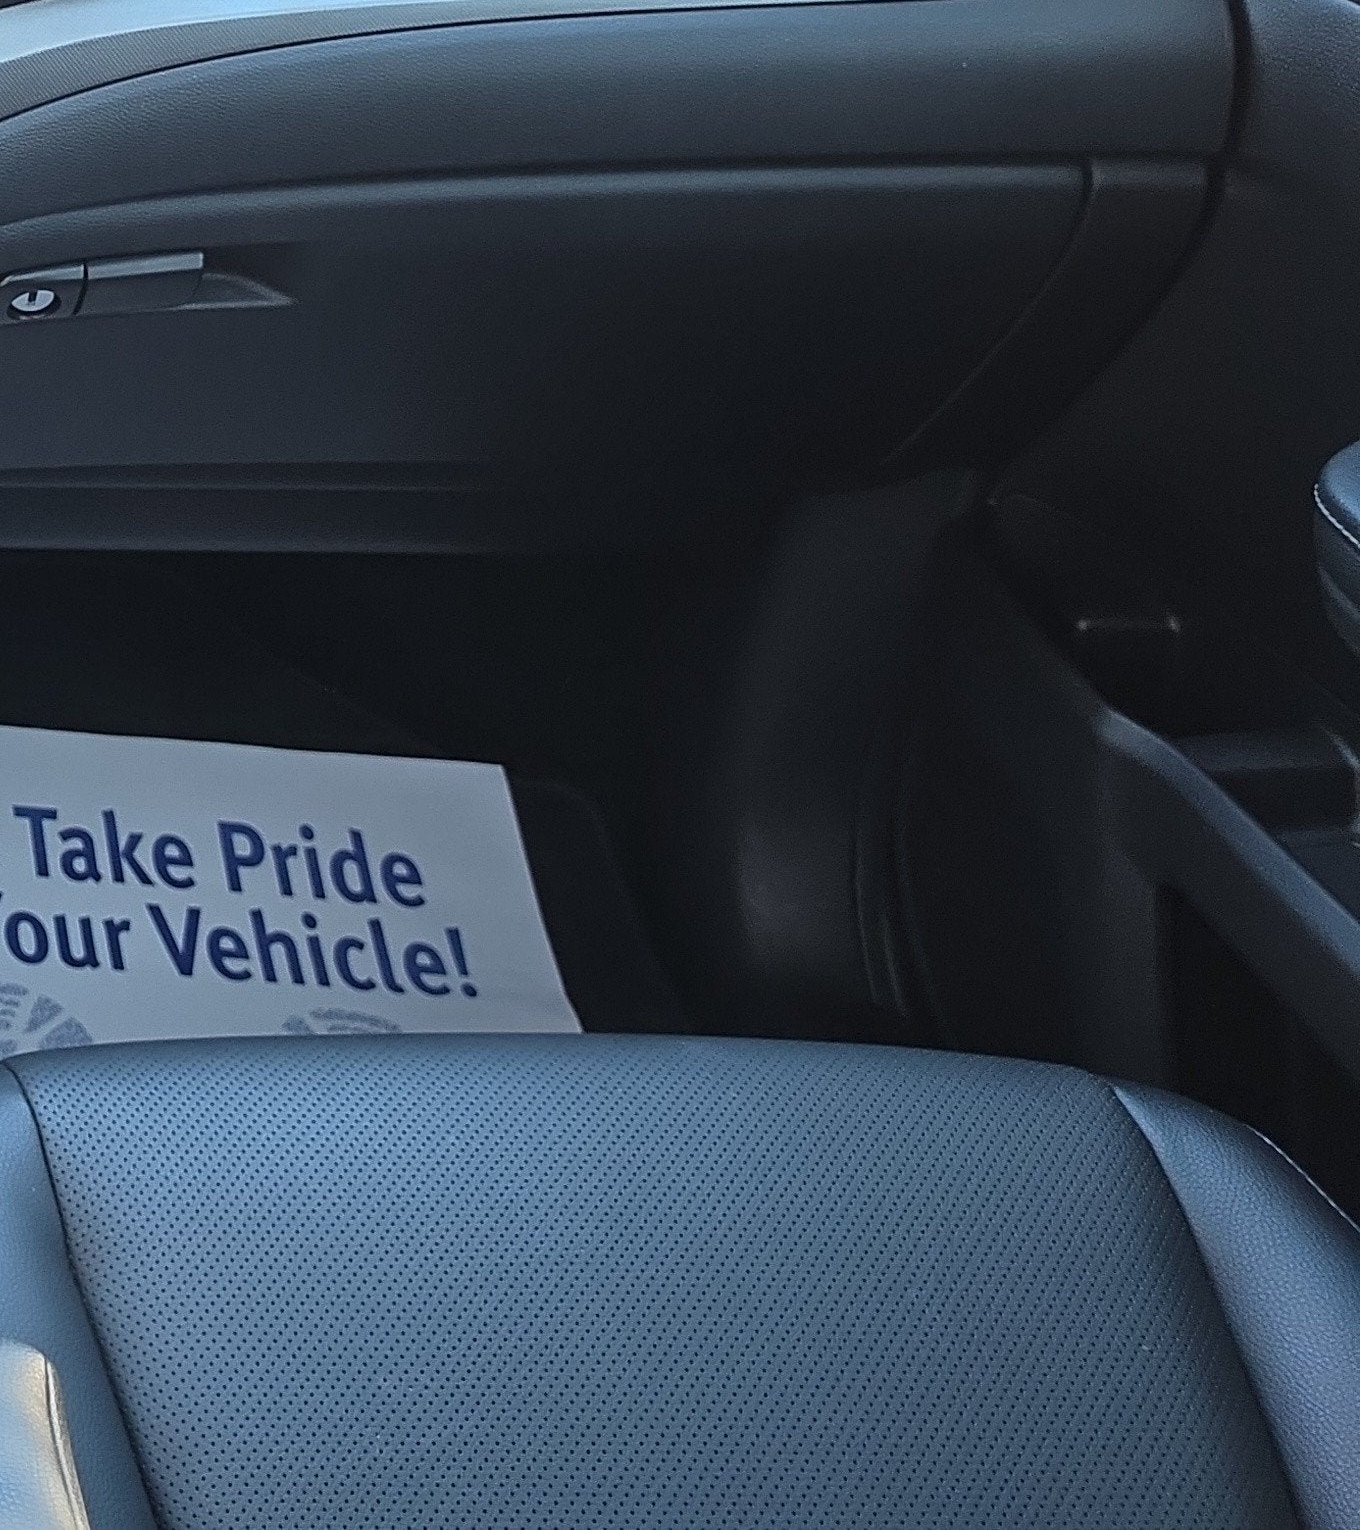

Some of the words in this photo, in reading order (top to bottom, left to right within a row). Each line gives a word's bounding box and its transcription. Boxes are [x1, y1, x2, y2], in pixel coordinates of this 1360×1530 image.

[11, 803, 196, 889] Take
[215, 819, 427, 908] Pride
[146, 903, 479, 998] Vehicle!
